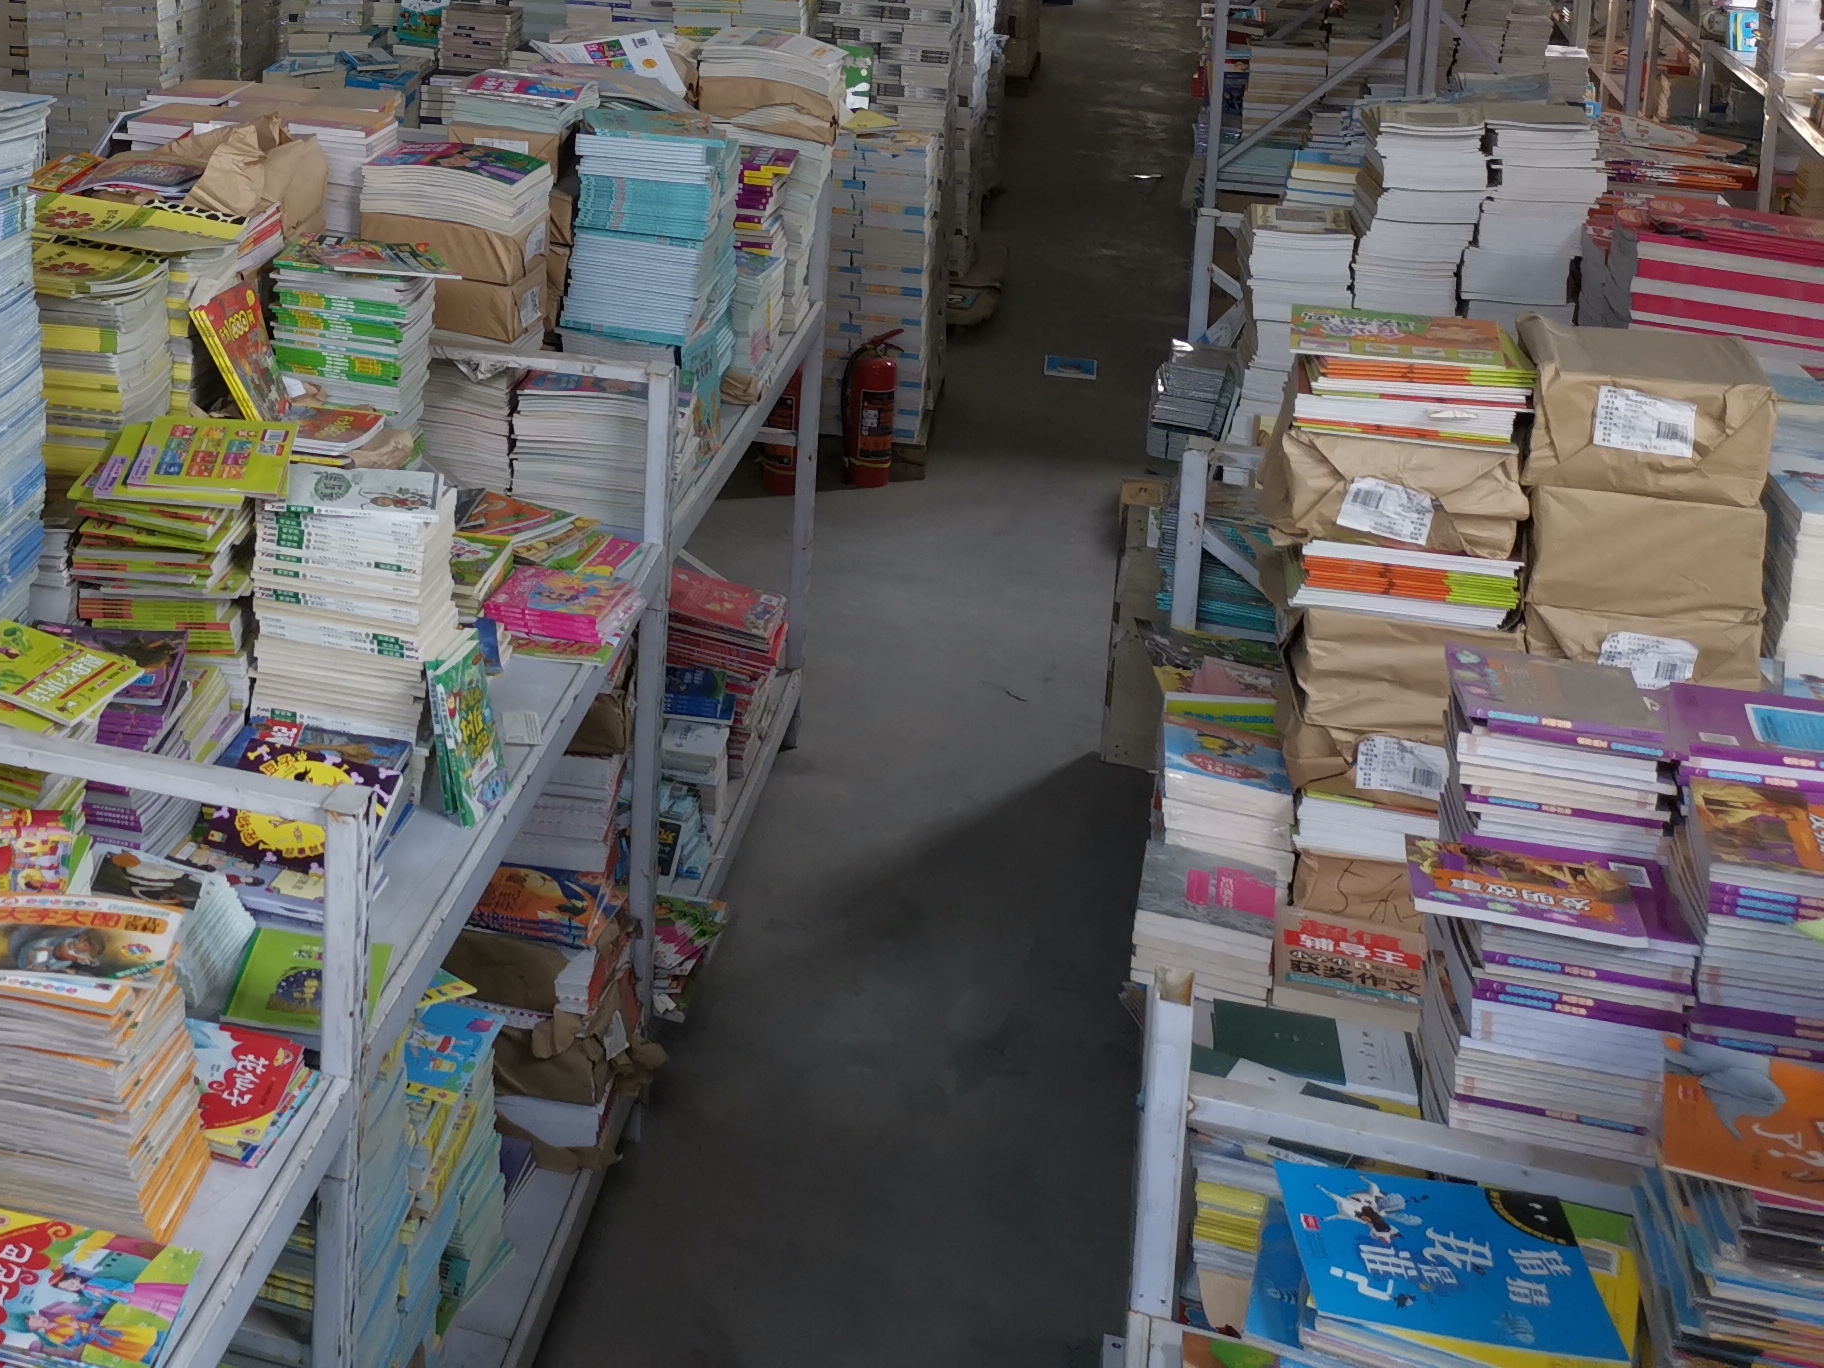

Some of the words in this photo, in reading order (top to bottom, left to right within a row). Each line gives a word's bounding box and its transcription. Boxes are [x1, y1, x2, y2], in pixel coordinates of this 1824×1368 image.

[1289, 958, 1422, 997] 获奖作文
[221, 1053, 270, 1108] 花仙子
